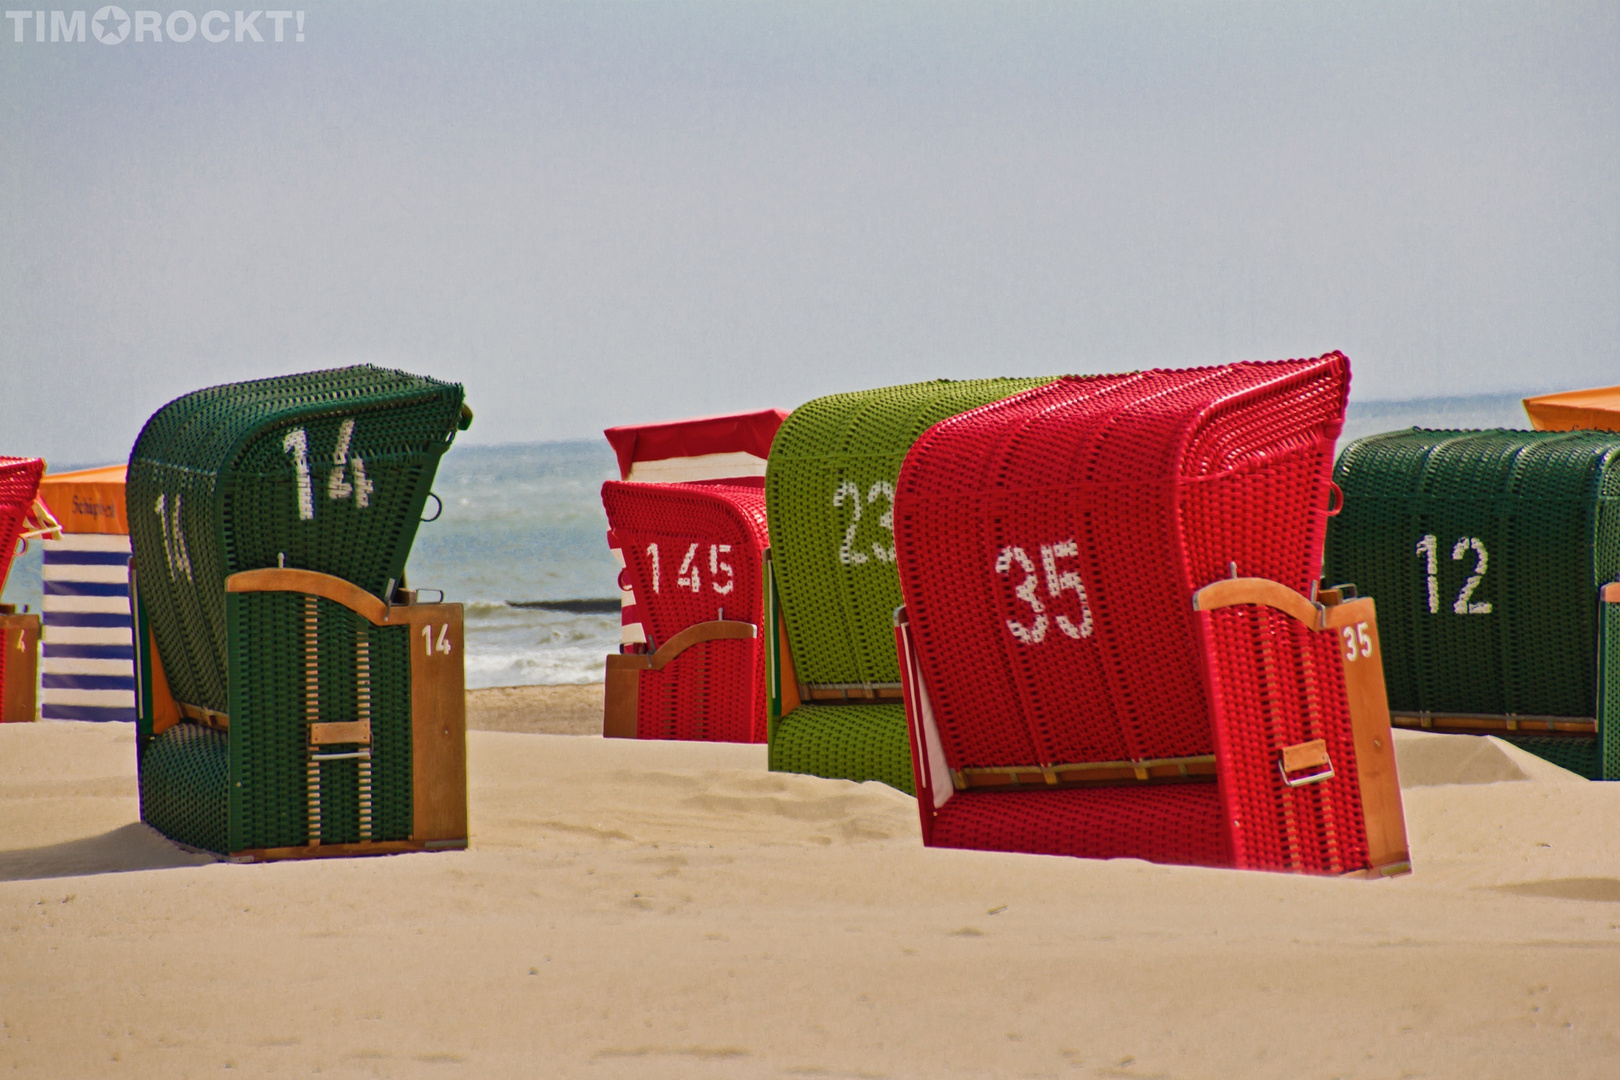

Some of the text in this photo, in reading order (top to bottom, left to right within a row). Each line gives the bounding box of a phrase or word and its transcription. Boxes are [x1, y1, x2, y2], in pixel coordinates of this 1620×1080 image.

[283, 419, 374, 520] 14
[833, 480, 897, 564] 23
[646, 543, 734, 595] 145
[995, 538, 1094, 644] 35
[1416, 534, 1492, 615] 12
[17, 629, 26, 653] 4
[421, 623, 452, 656] 14
[1343, 621, 1372, 662] 35
